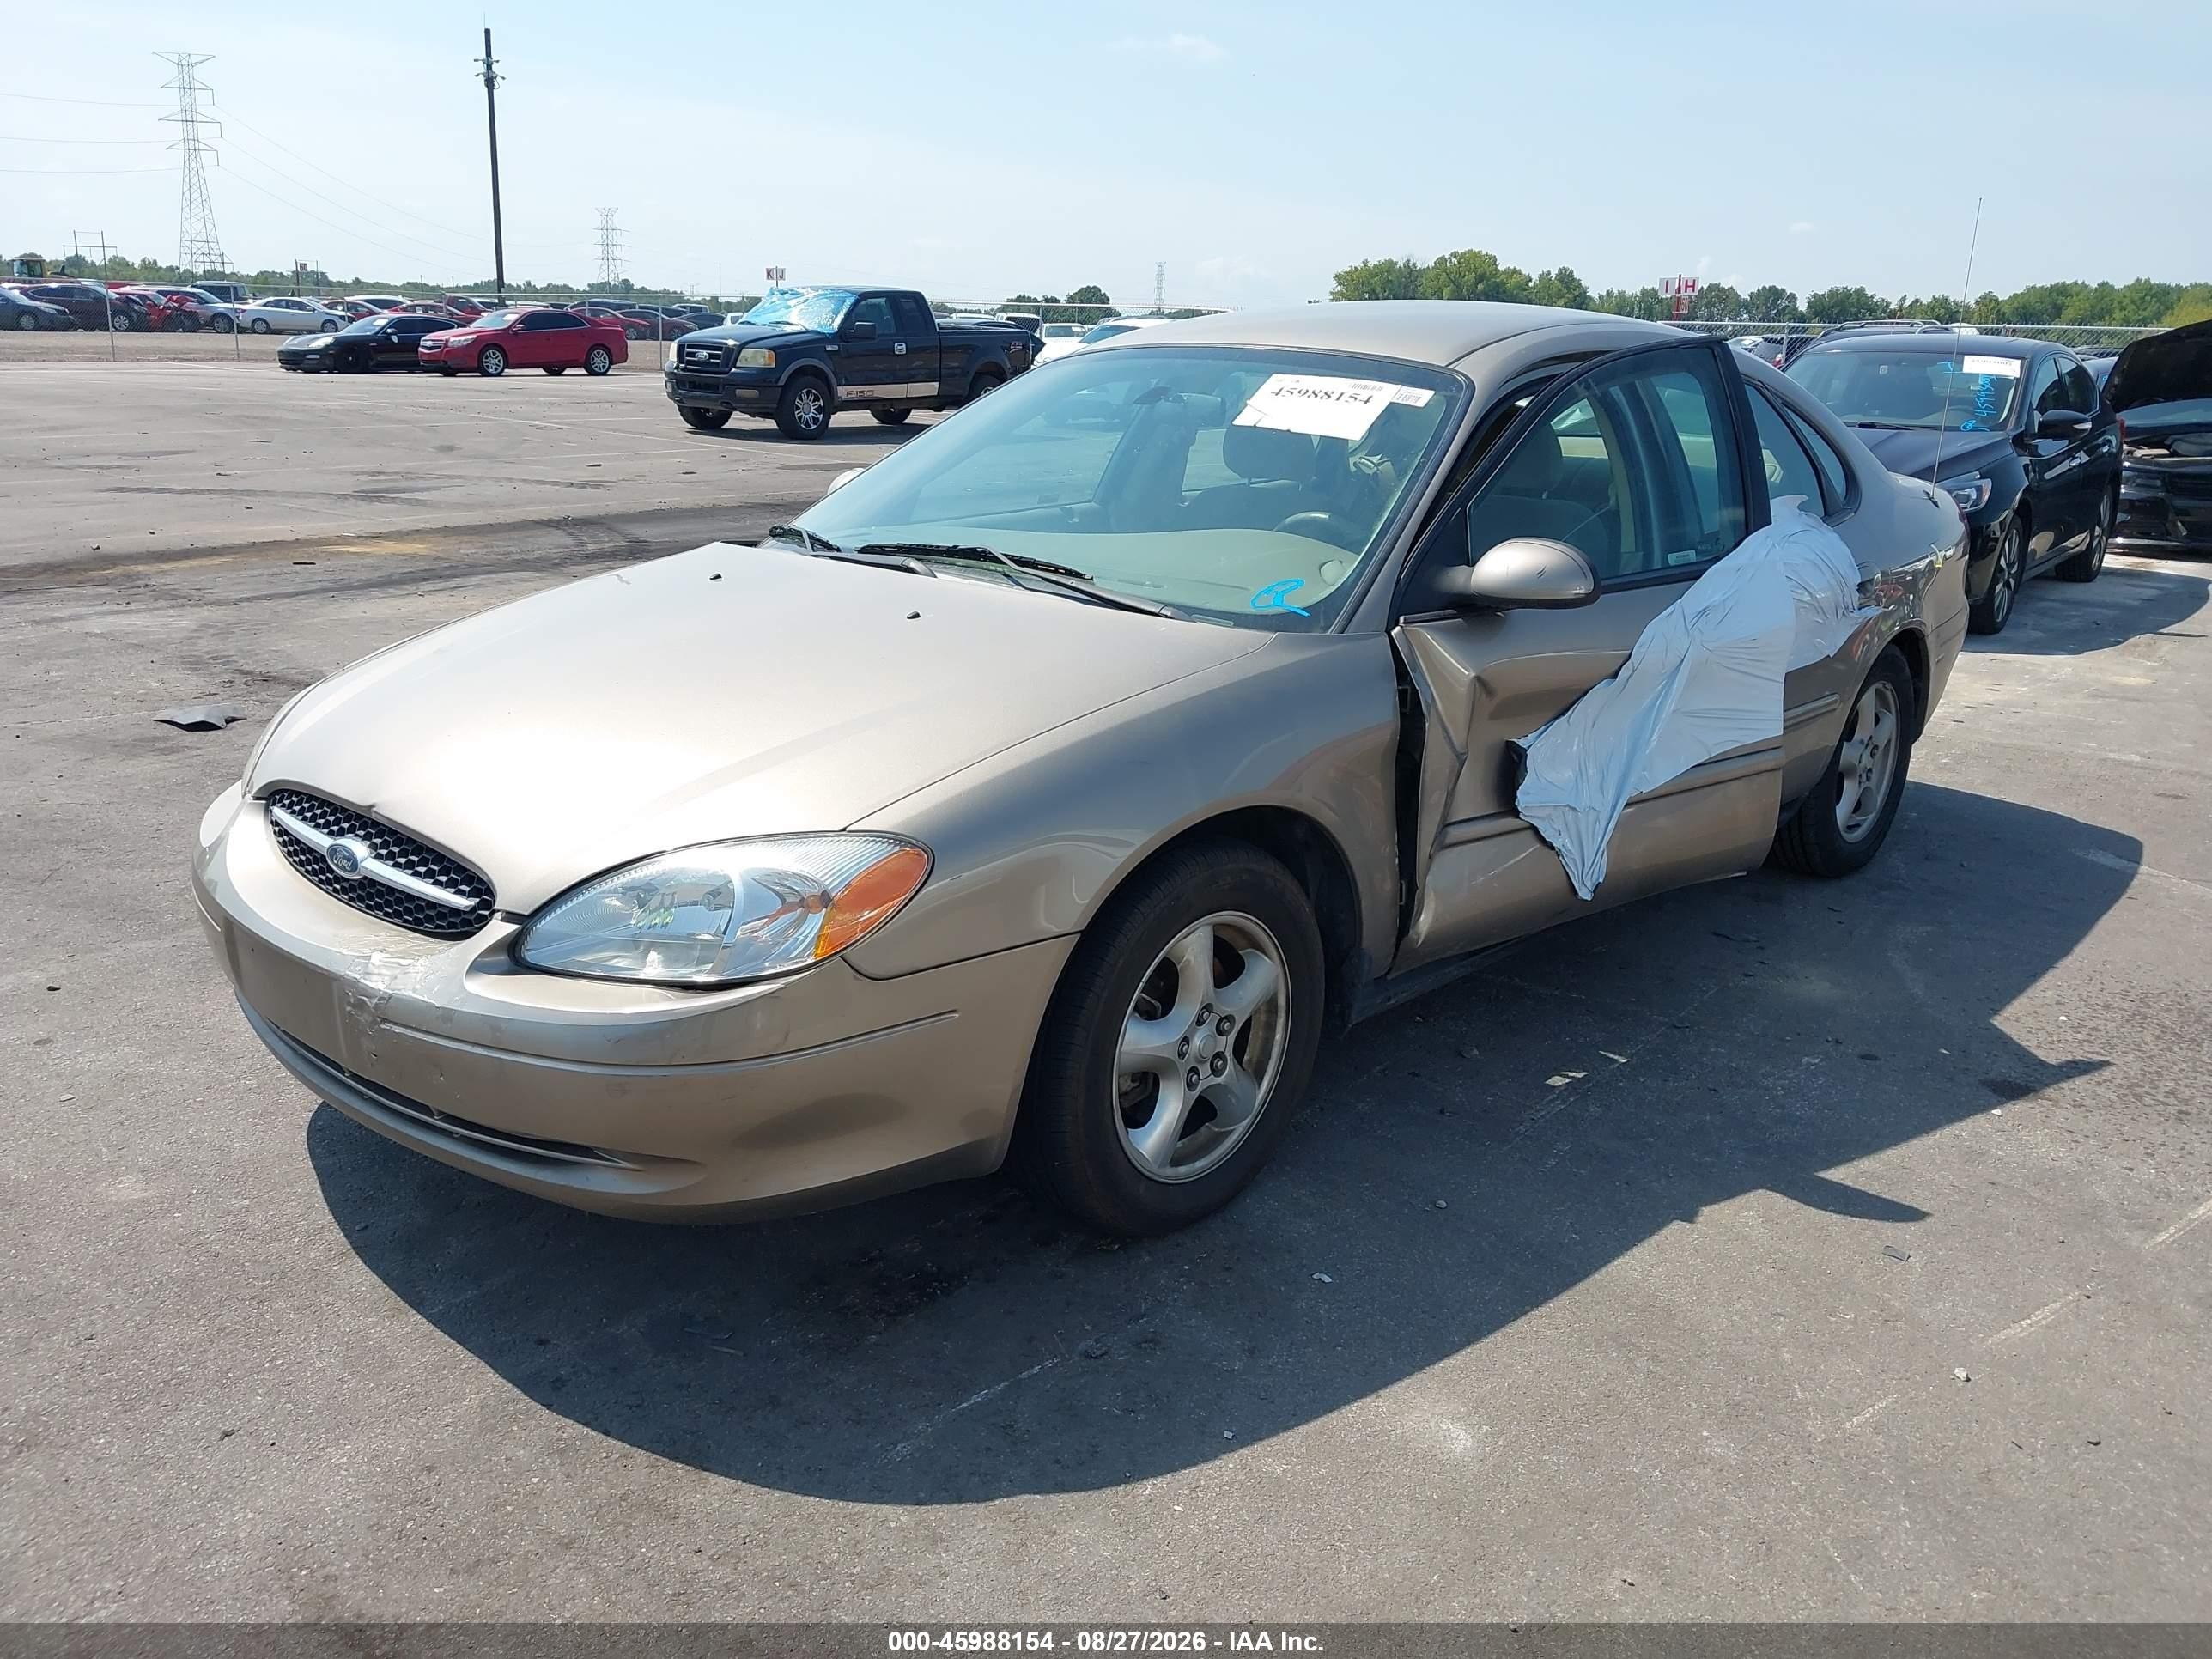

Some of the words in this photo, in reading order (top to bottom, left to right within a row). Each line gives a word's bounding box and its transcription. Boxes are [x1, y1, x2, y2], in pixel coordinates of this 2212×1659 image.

[299, 263, 308, 272] 60
[765, 268, 774, 280] K
[1684, 278, 1697, 294] H
[1270, 386, 1375, 405] 45988154
[332, 848, 355, 872] Ford
